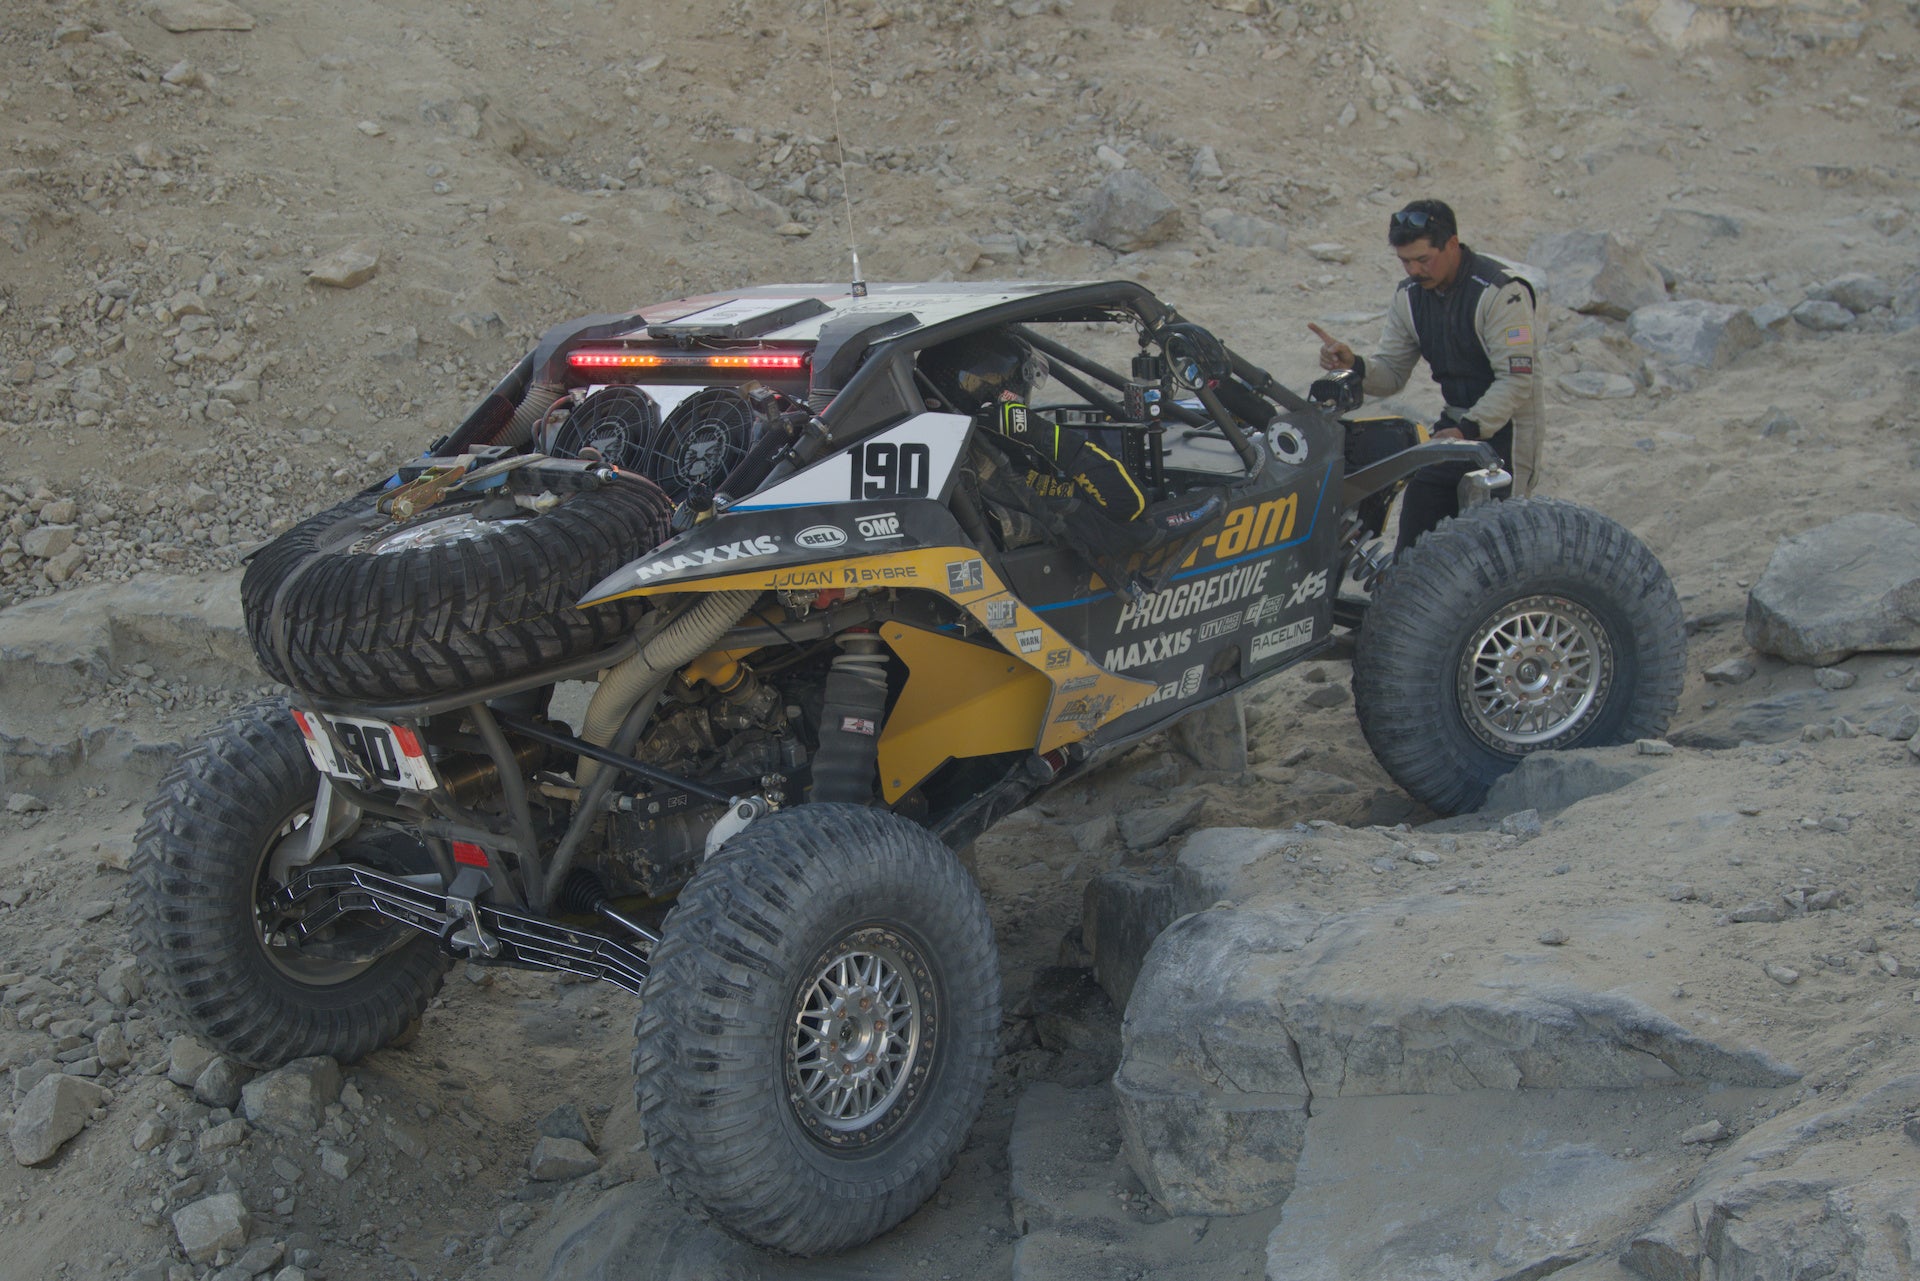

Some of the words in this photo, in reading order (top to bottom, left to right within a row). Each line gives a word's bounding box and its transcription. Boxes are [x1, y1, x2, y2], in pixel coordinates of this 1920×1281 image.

[1016, 408, 1025, 433] OMP
[847, 442, 930, 500] 190
[802, 531, 840, 545] BELL
[857, 515, 900, 539] OMP
[636, 536, 780, 580] MAXXIS
[861, 566, 918, 581] BYBRE
[1115, 559, 1273, 634] PROGRESSIVE
[1285, 568, 1329, 608] XPS
[987, 600, 1015, 620] SHIFT
[1020, 635, 1040, 647] WARN
[1200, 619, 1223, 640] UTV
[1252, 619, 1313, 652] RACELINE
[1103, 628, 1193, 672] MAXXIS
